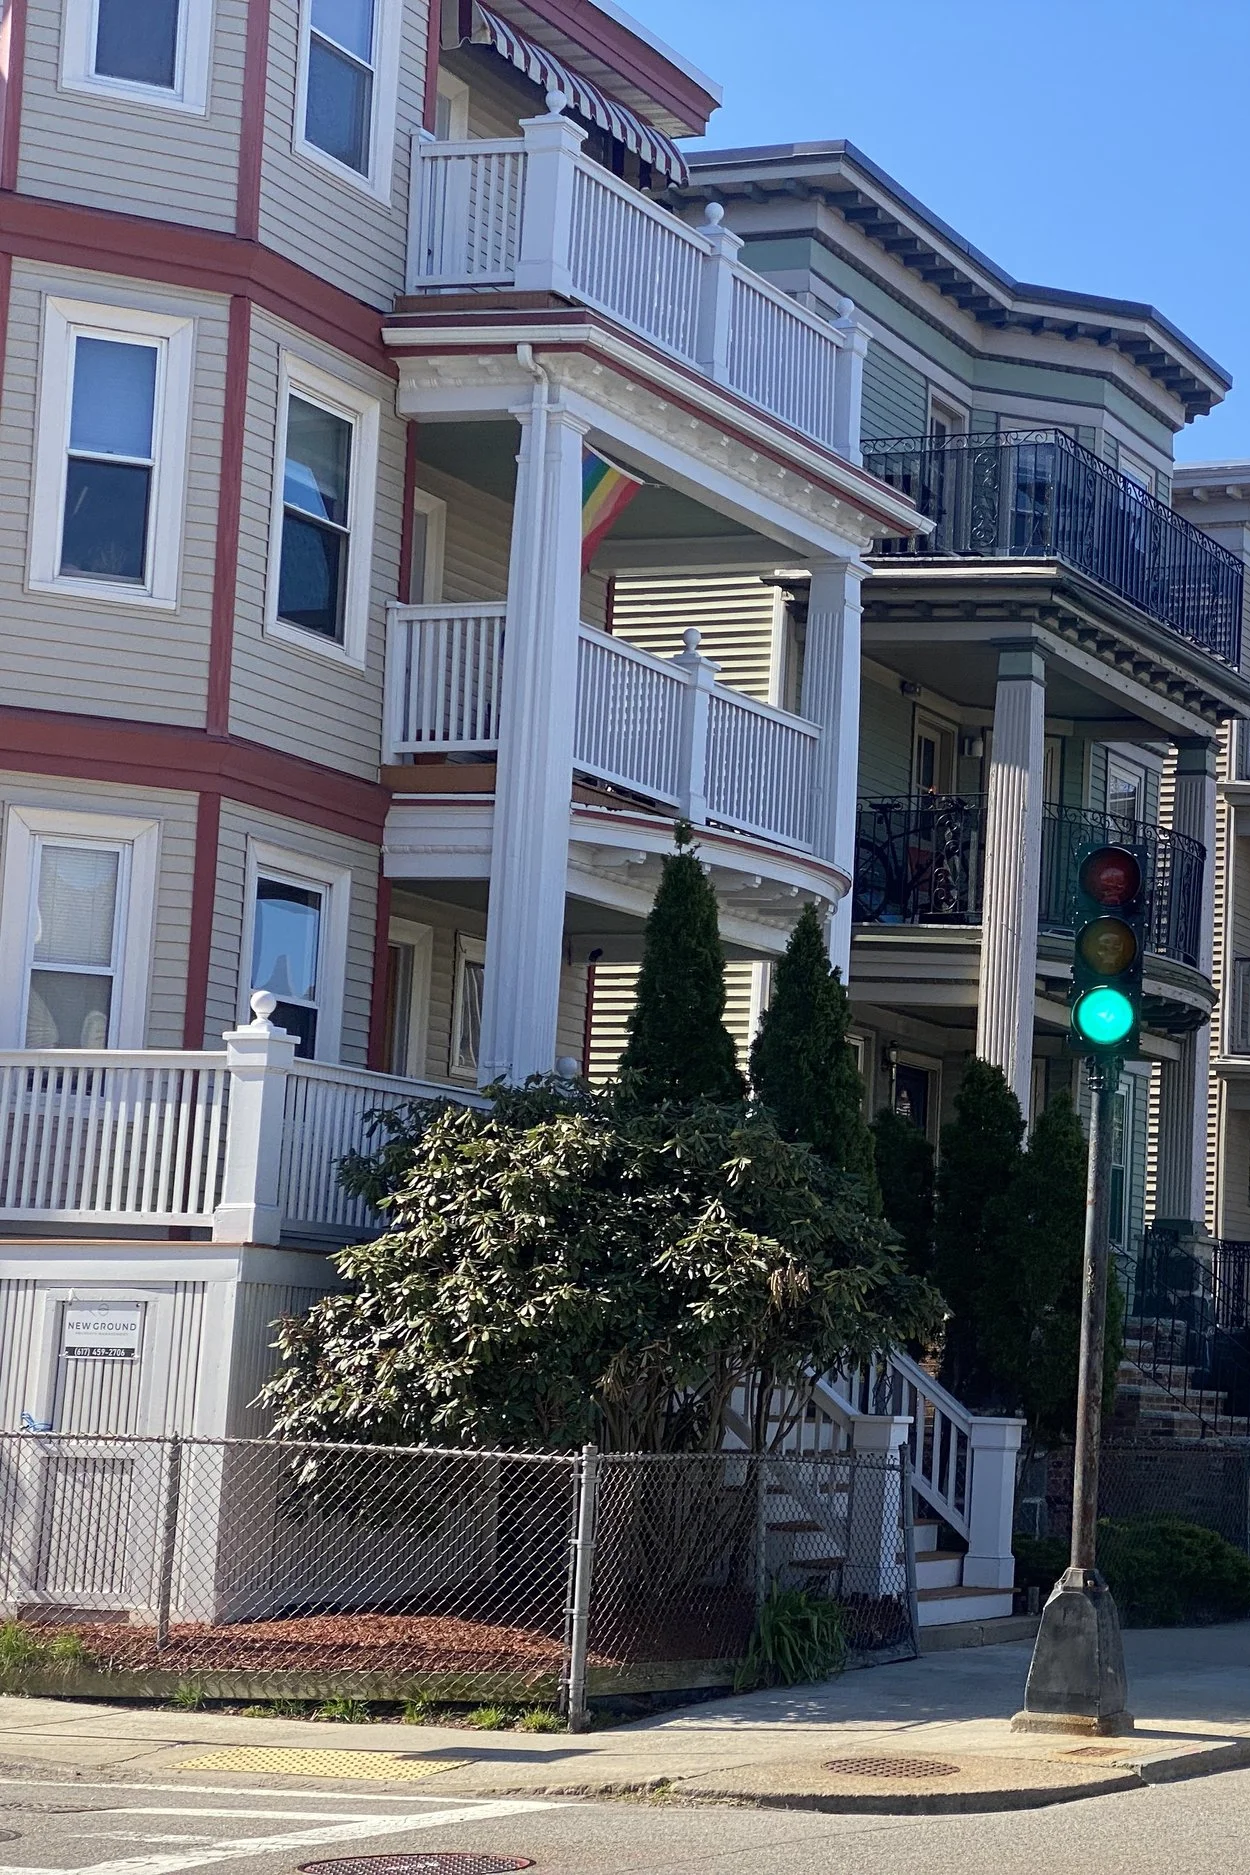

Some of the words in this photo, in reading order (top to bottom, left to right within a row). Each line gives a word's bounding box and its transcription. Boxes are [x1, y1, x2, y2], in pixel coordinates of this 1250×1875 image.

[68, 1322, 91, 1330] NEW
[93, 1322, 137, 1331] GROUND
[74, 1348, 90, 1356] (617)
[92, 1348, 125, 1357] 459-2706
